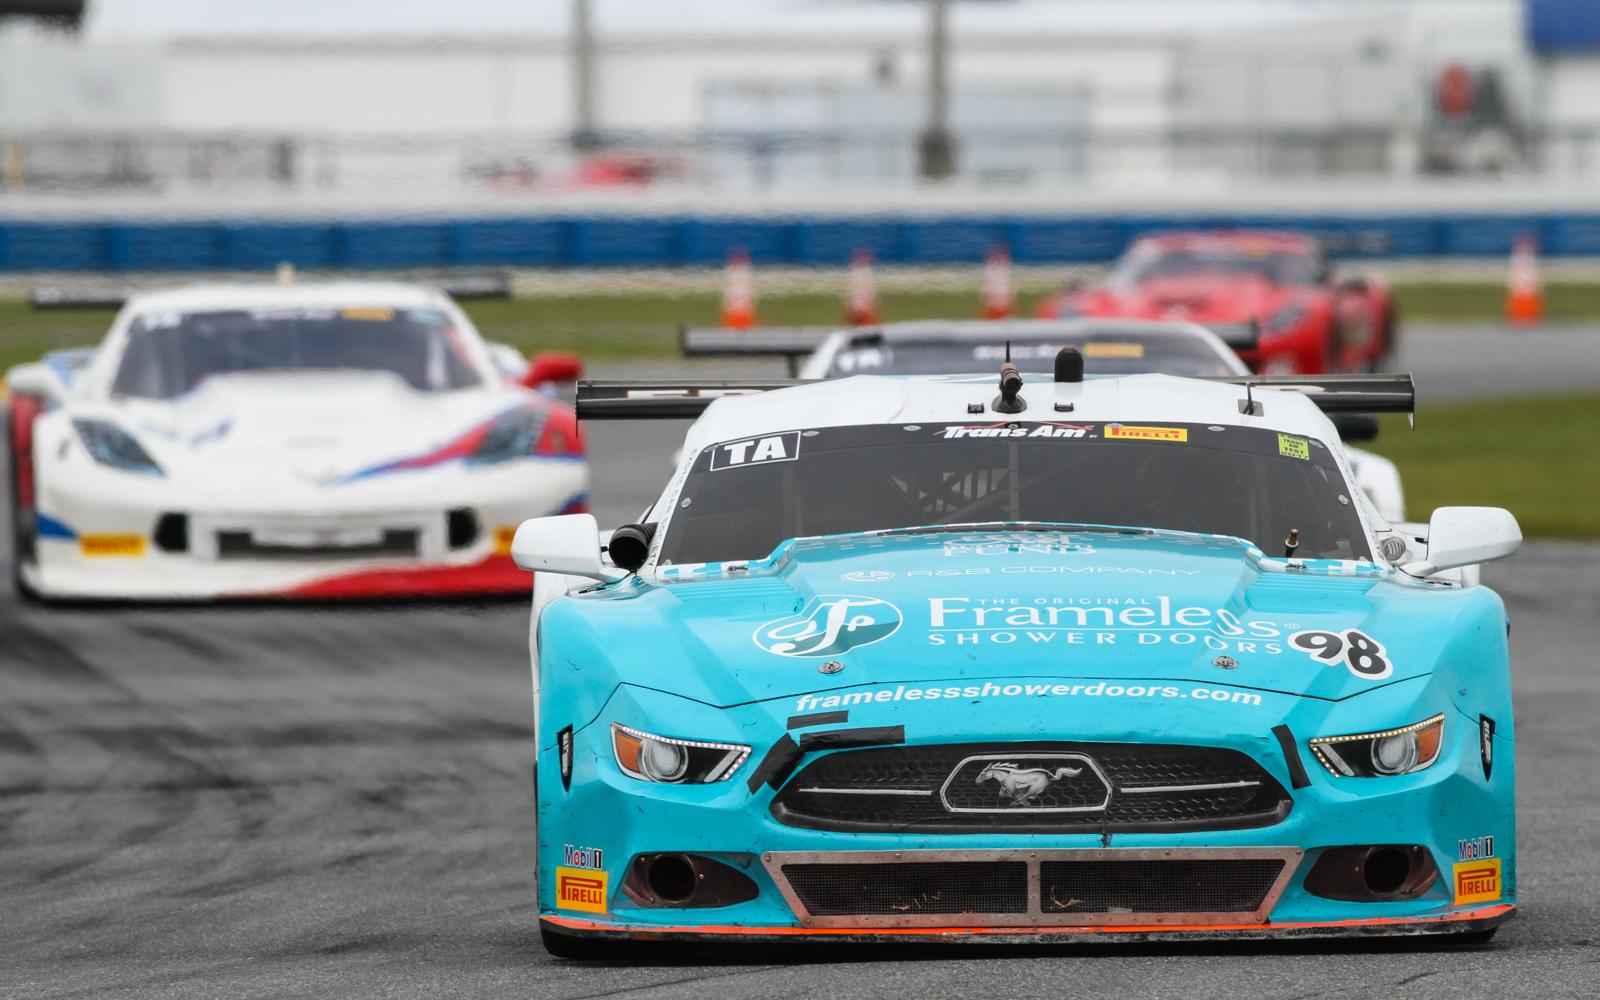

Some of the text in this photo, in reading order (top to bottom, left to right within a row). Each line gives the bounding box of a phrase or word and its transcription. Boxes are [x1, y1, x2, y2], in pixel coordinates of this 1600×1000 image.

[943, 425, 1087, 439] Trans Am
[723, 436, 787, 465] TA
[1034, 597, 1151, 605] ORIGINAL
[928, 631, 1282, 655] SHOWER DOORS
[1288, 627, 1394, 680] 98
[795, 681, 1263, 712] framelessshowerdoors.com
[564, 844, 592, 868] Mobil
[1458, 837, 1485, 861] Mobil
[560, 876, 603, 905] PIRELLI
[1457, 868, 1496, 896] PIRELLI
